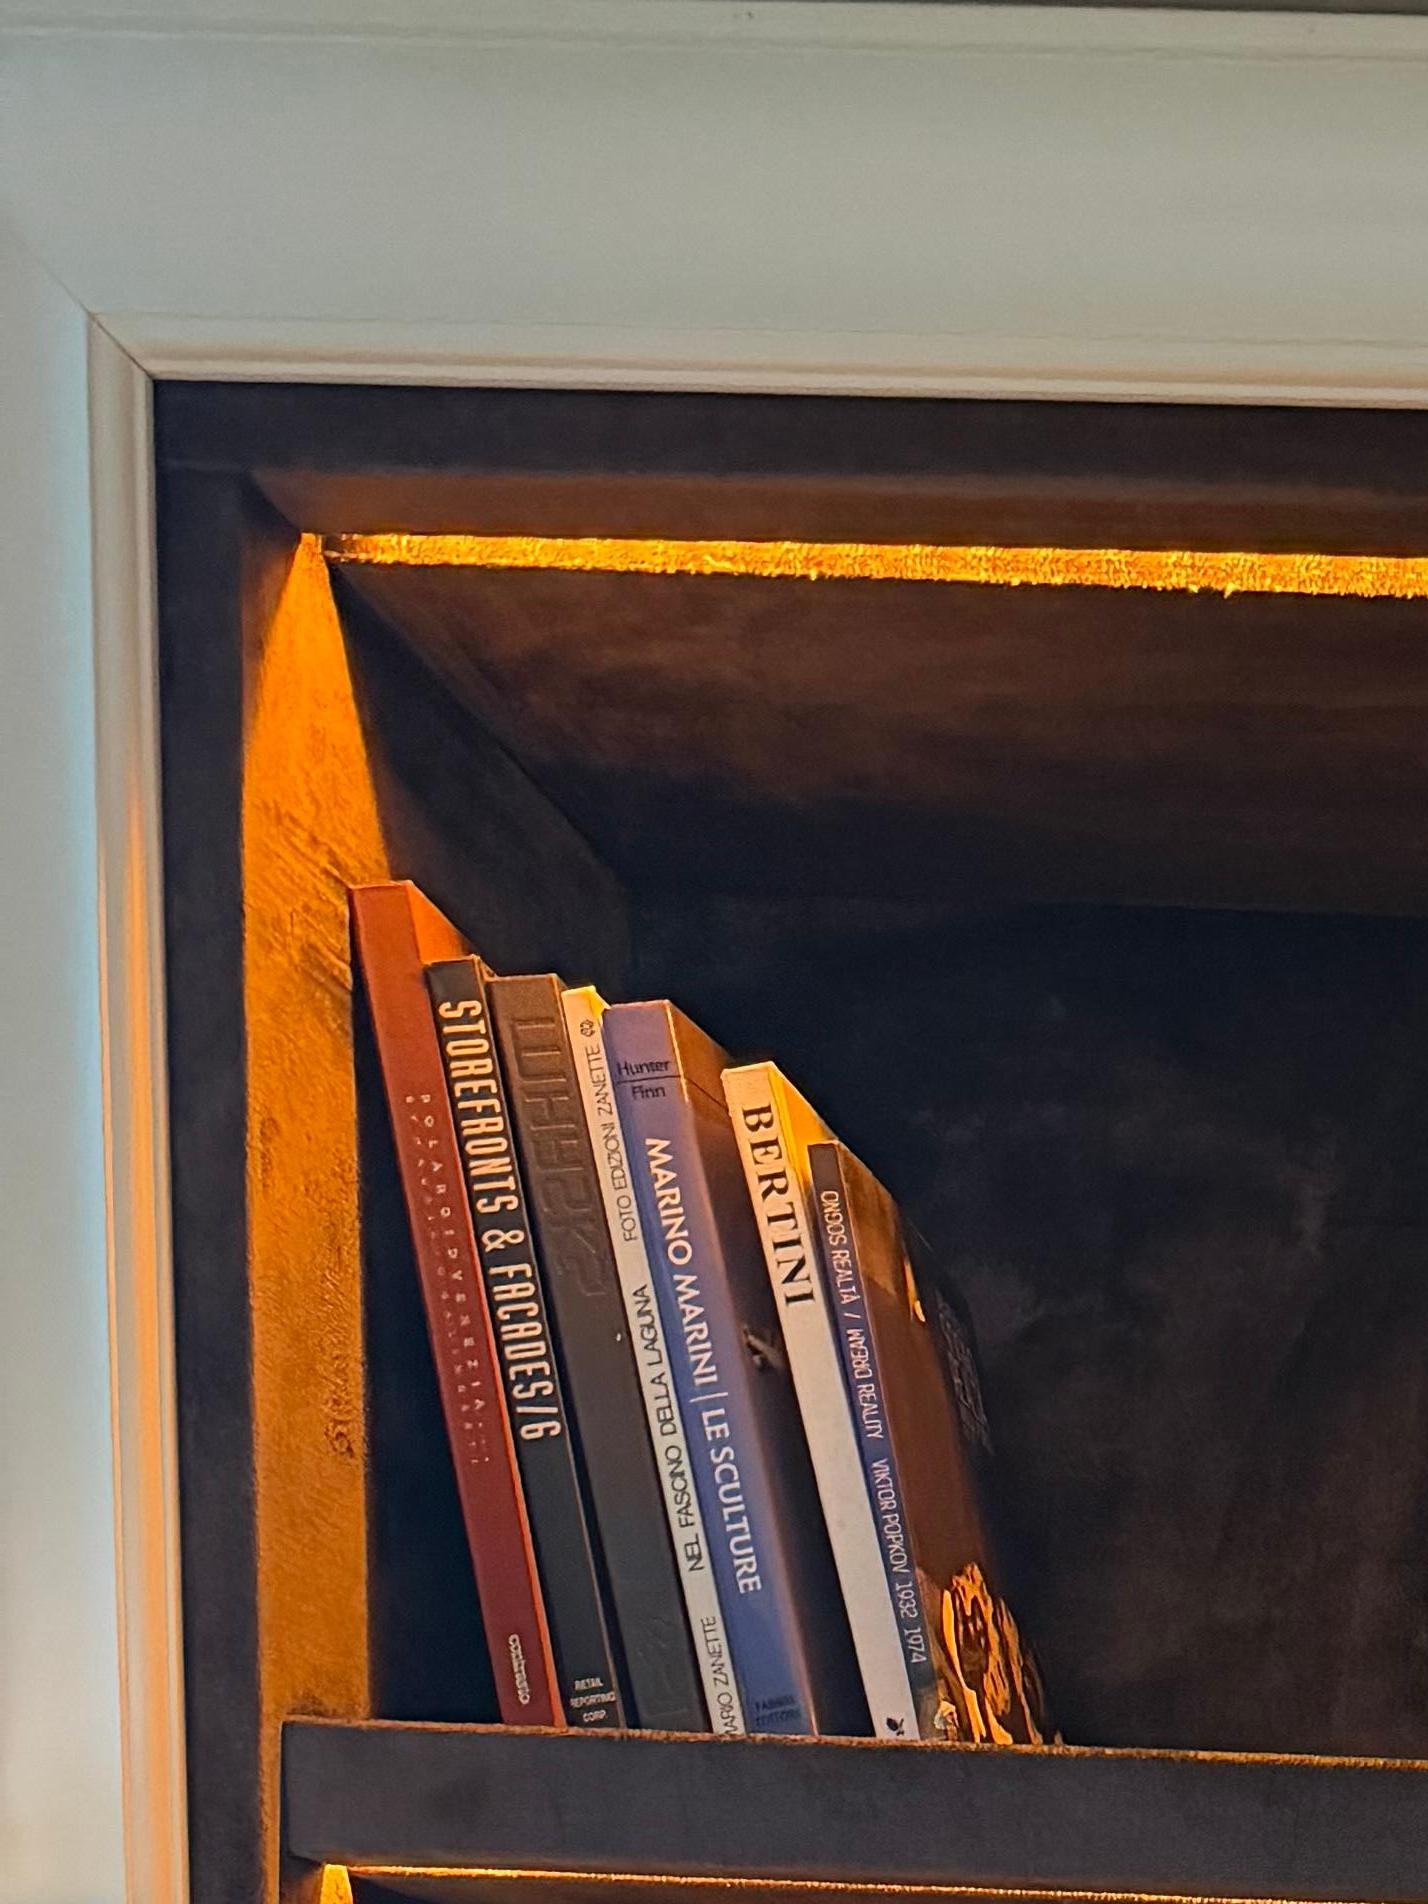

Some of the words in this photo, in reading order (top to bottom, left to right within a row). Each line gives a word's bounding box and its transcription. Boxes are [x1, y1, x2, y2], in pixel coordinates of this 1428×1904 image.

[585, 1044, 614, 1117] ZANETTE
[616, 1059, 672, 1076] Hunter
[631, 1083, 667, 1099] Finn
[438, 999, 519, 1214] STOREFRONTS
[600, 1119, 629, 1192] EDIZIONI
[612, 1196, 638, 1243] FOTO
[644, 1138, 693, 1267] MARINO
[740, 1104, 817, 1307] BERTINI
[481, 1228, 525, 1253] &
[489, 1262, 562, 1440] FACADES/6
[632, 1283, 666, 1368] LAGUNA
[674, 1273, 718, 1386] MARINI
[649, 1371, 678, 1437] DELLA
[702, 1408, 730, 1442] LE
[857, 1383, 885, 1441] REALITY
[666, 1444, 697, 1529] FASCINO
[871, 1458, 897, 1512] VIKTOR
[684, 1532, 704, 1573] NEL
[709, 1447, 763, 1595] SCULTURE
[882, 1513, 909, 1573] POPKOV
[895, 1580, 919, 1619] 1932
[700, 1615, 730, 1689] ZANETTE
[902, 1626, 928, 1665] 1974
